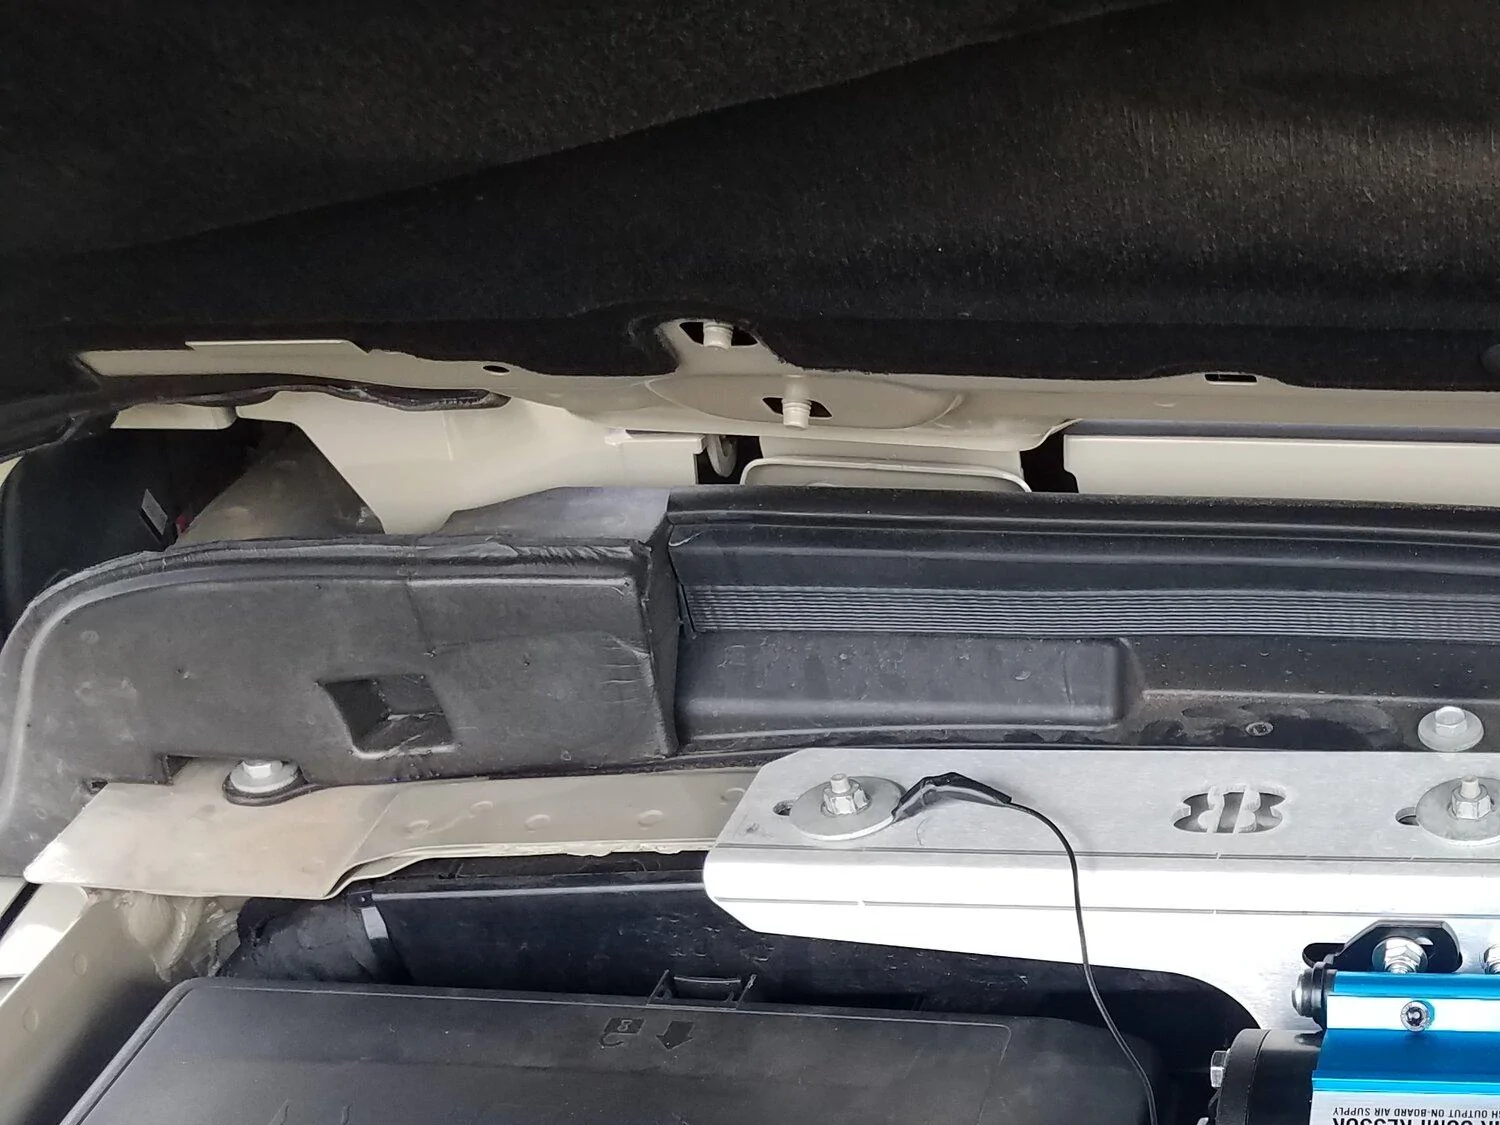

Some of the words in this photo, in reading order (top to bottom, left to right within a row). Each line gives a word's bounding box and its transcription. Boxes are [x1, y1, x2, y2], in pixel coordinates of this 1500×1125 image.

[1333, 1106, 1371, 1116] SUPPLY
[1374, 1107, 1390, 1116] AIR
[1394, 1108, 1446, 1118] ON-BOARD
[1449, 1109, 1488, 1119] OUTPUT
